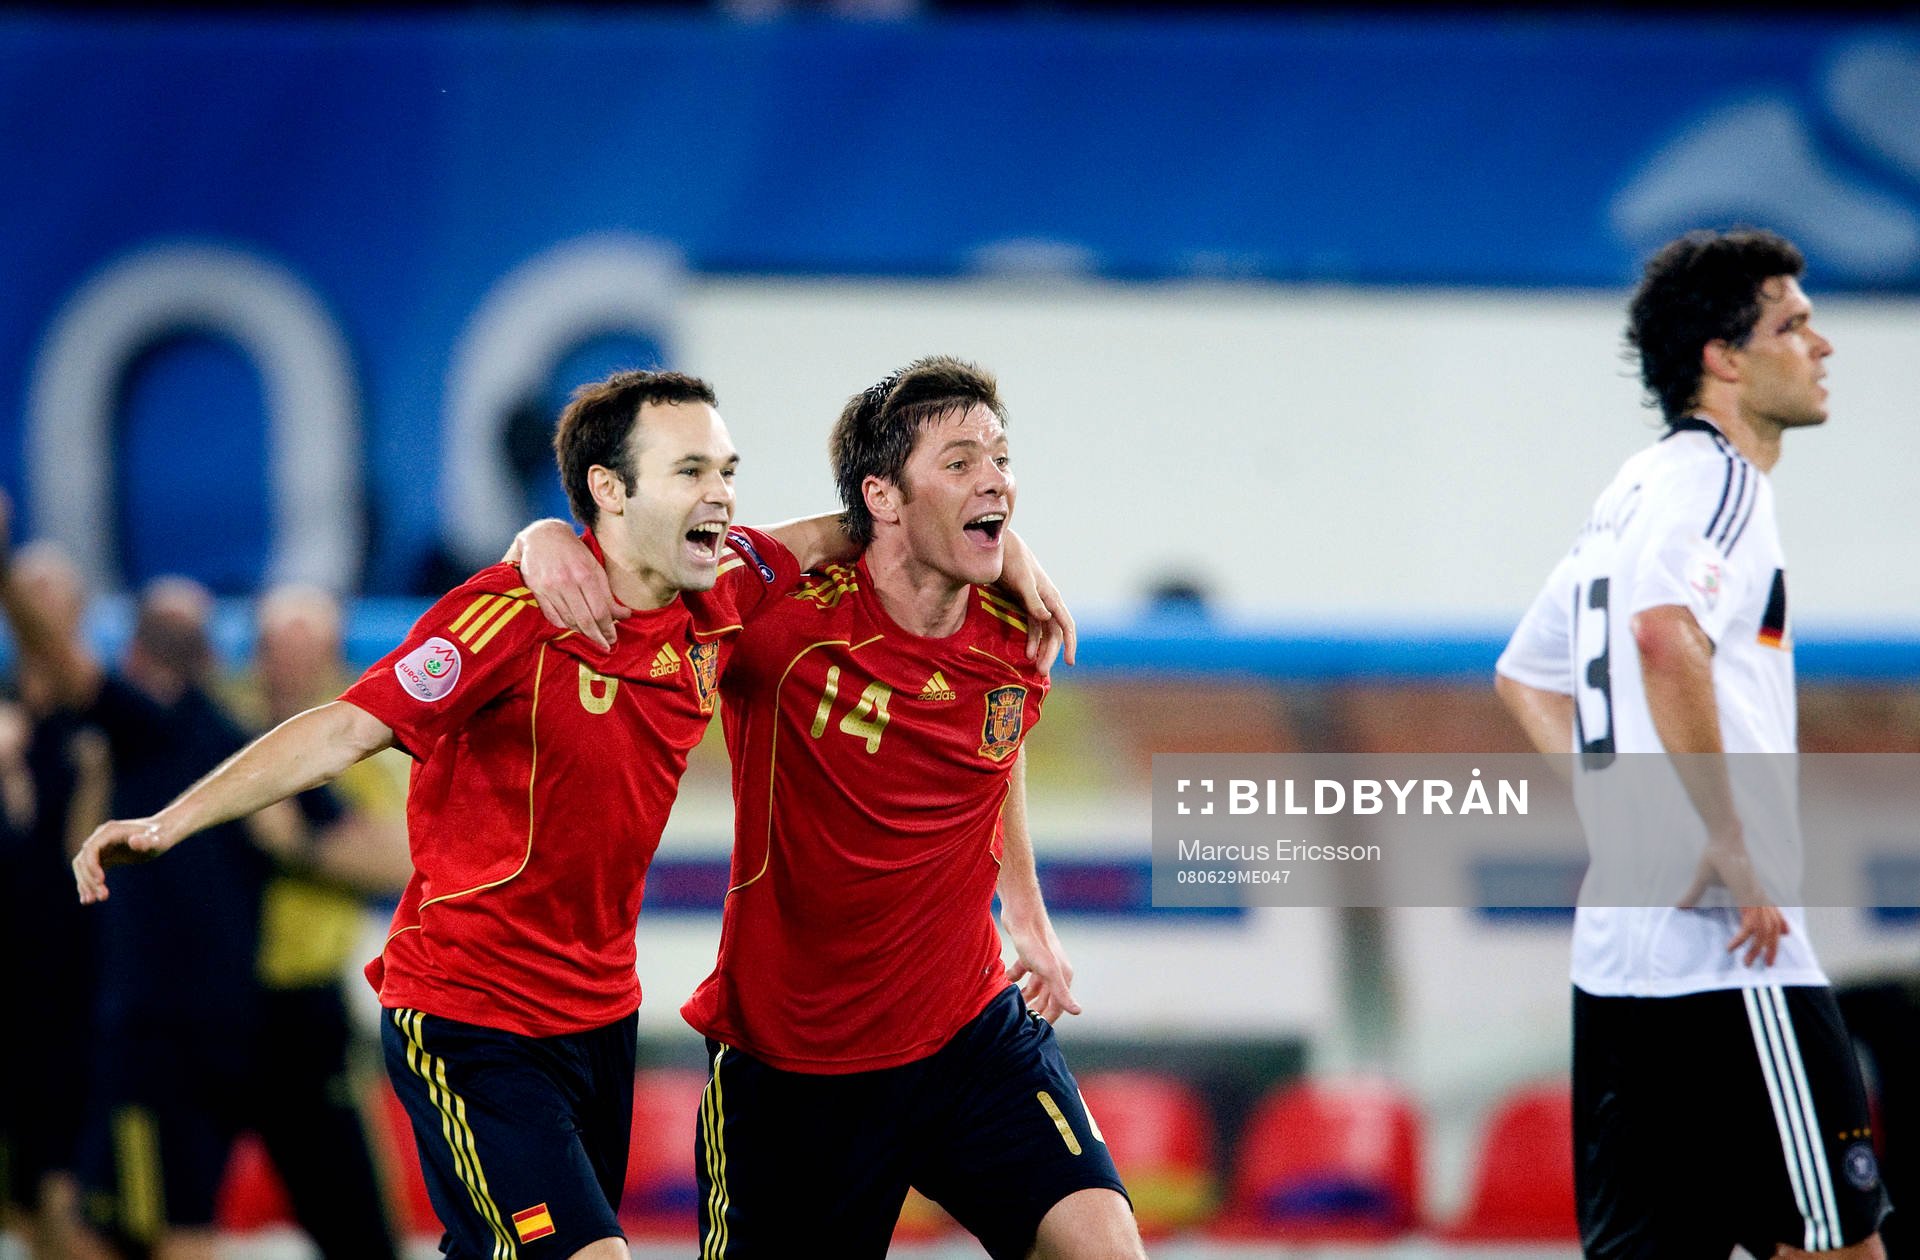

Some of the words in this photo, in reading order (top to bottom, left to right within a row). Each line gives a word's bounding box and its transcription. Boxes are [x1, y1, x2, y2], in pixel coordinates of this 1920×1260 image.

[650, 662, 681, 678] adida
[917, 690, 957, 701] adidas
[1573, 577, 1617, 773] 13
[810, 665, 893, 754] 14
